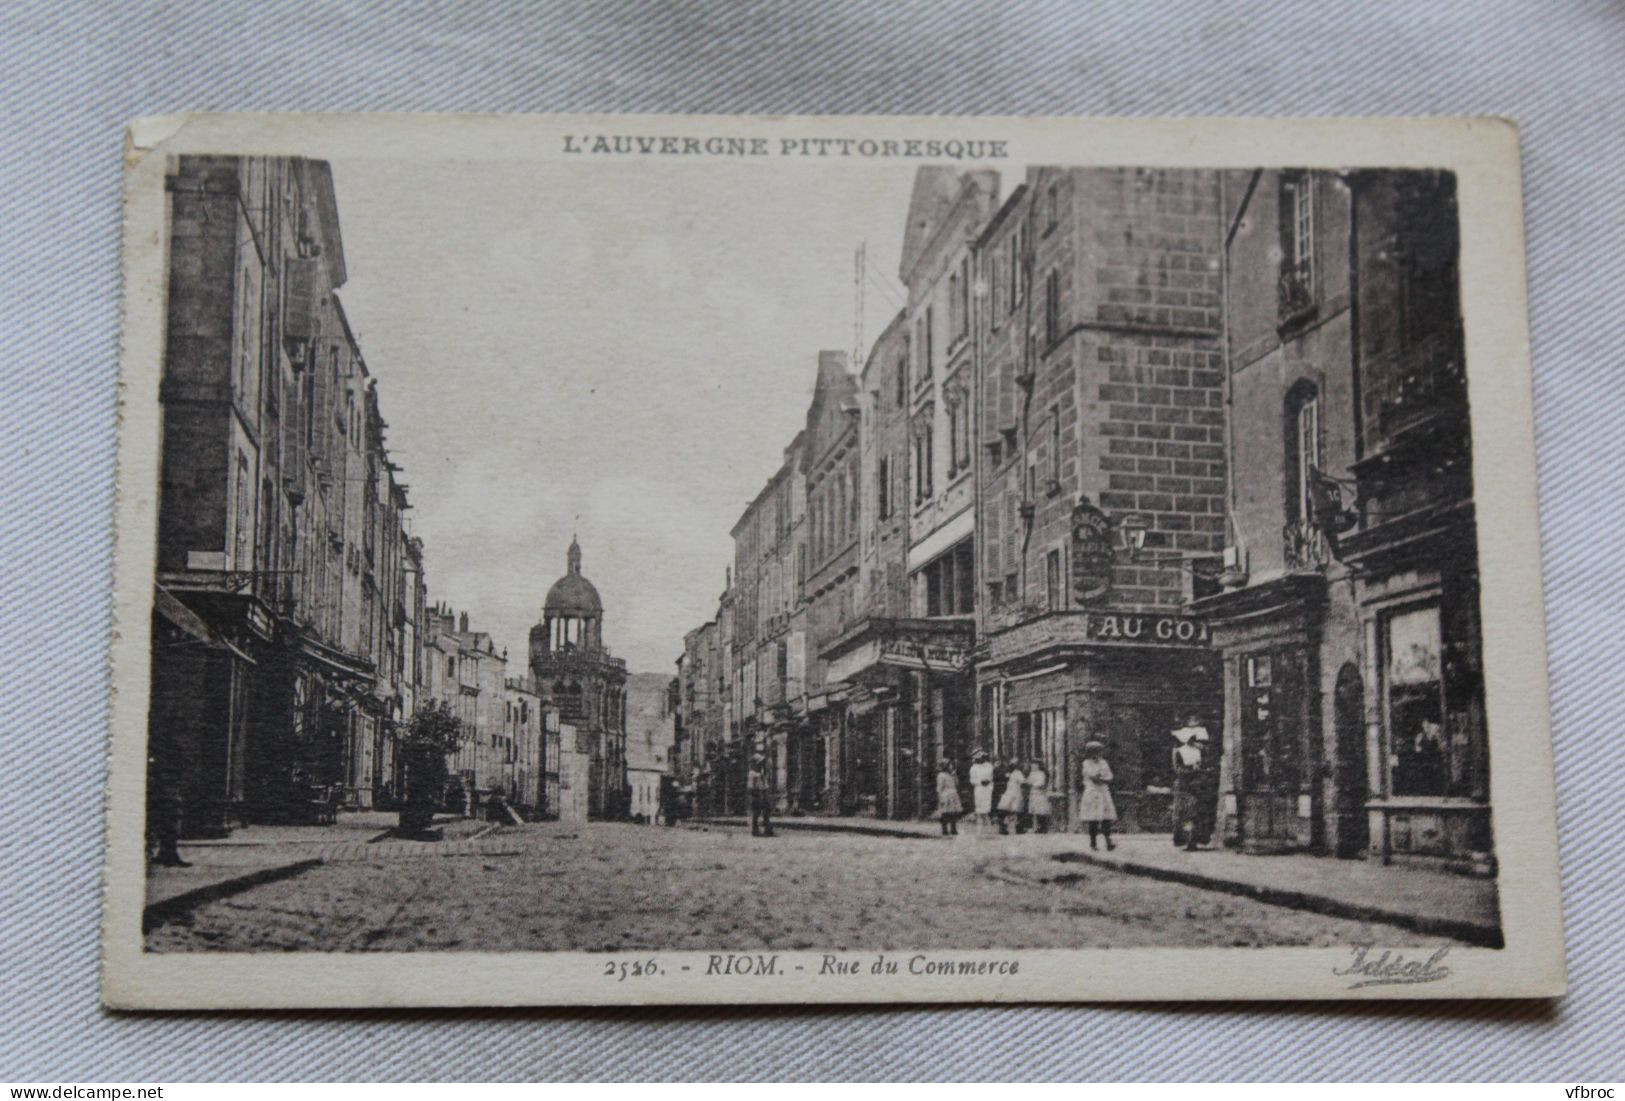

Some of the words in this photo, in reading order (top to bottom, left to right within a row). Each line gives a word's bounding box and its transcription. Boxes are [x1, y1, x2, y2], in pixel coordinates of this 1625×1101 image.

[561, 135, 770, 157] L'AUVERGNE
[779, 137, 1010, 159] PITTORESQUE
[1097, 615, 1143, 638] AU
[704, 954, 785, 976] RIOM.
[817, 954, 861, 976] Rue
[870, 954, 899, 976] du
[907, 954, 1020, 976] Commerce
